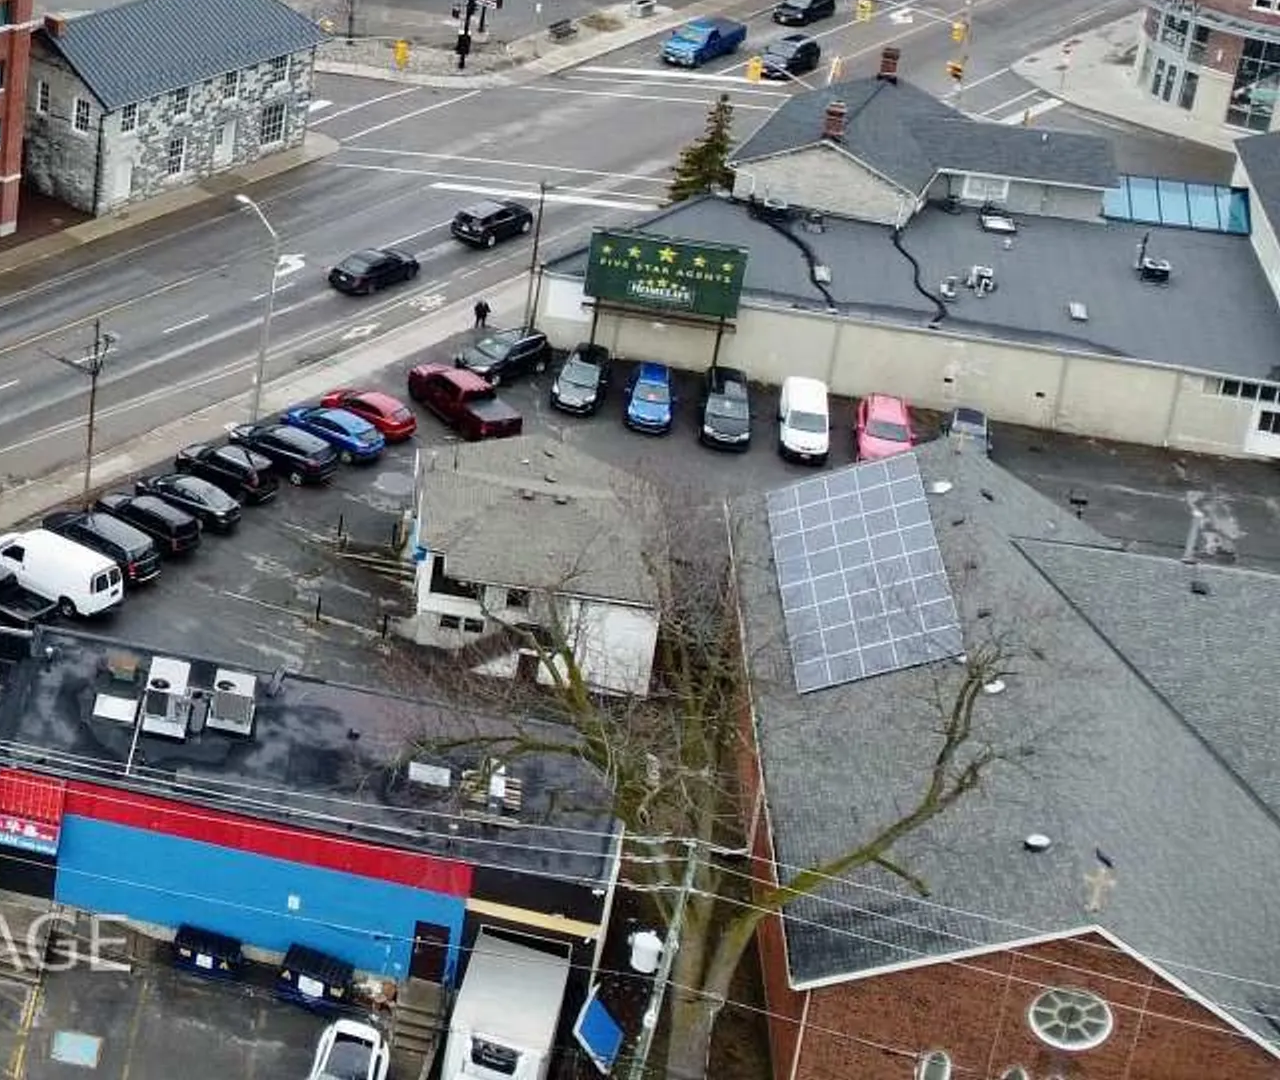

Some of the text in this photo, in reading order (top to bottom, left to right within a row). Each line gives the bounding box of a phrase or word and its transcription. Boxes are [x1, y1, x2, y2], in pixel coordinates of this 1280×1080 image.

[600, 257, 732, 284] FIVE STAR AGENTS
